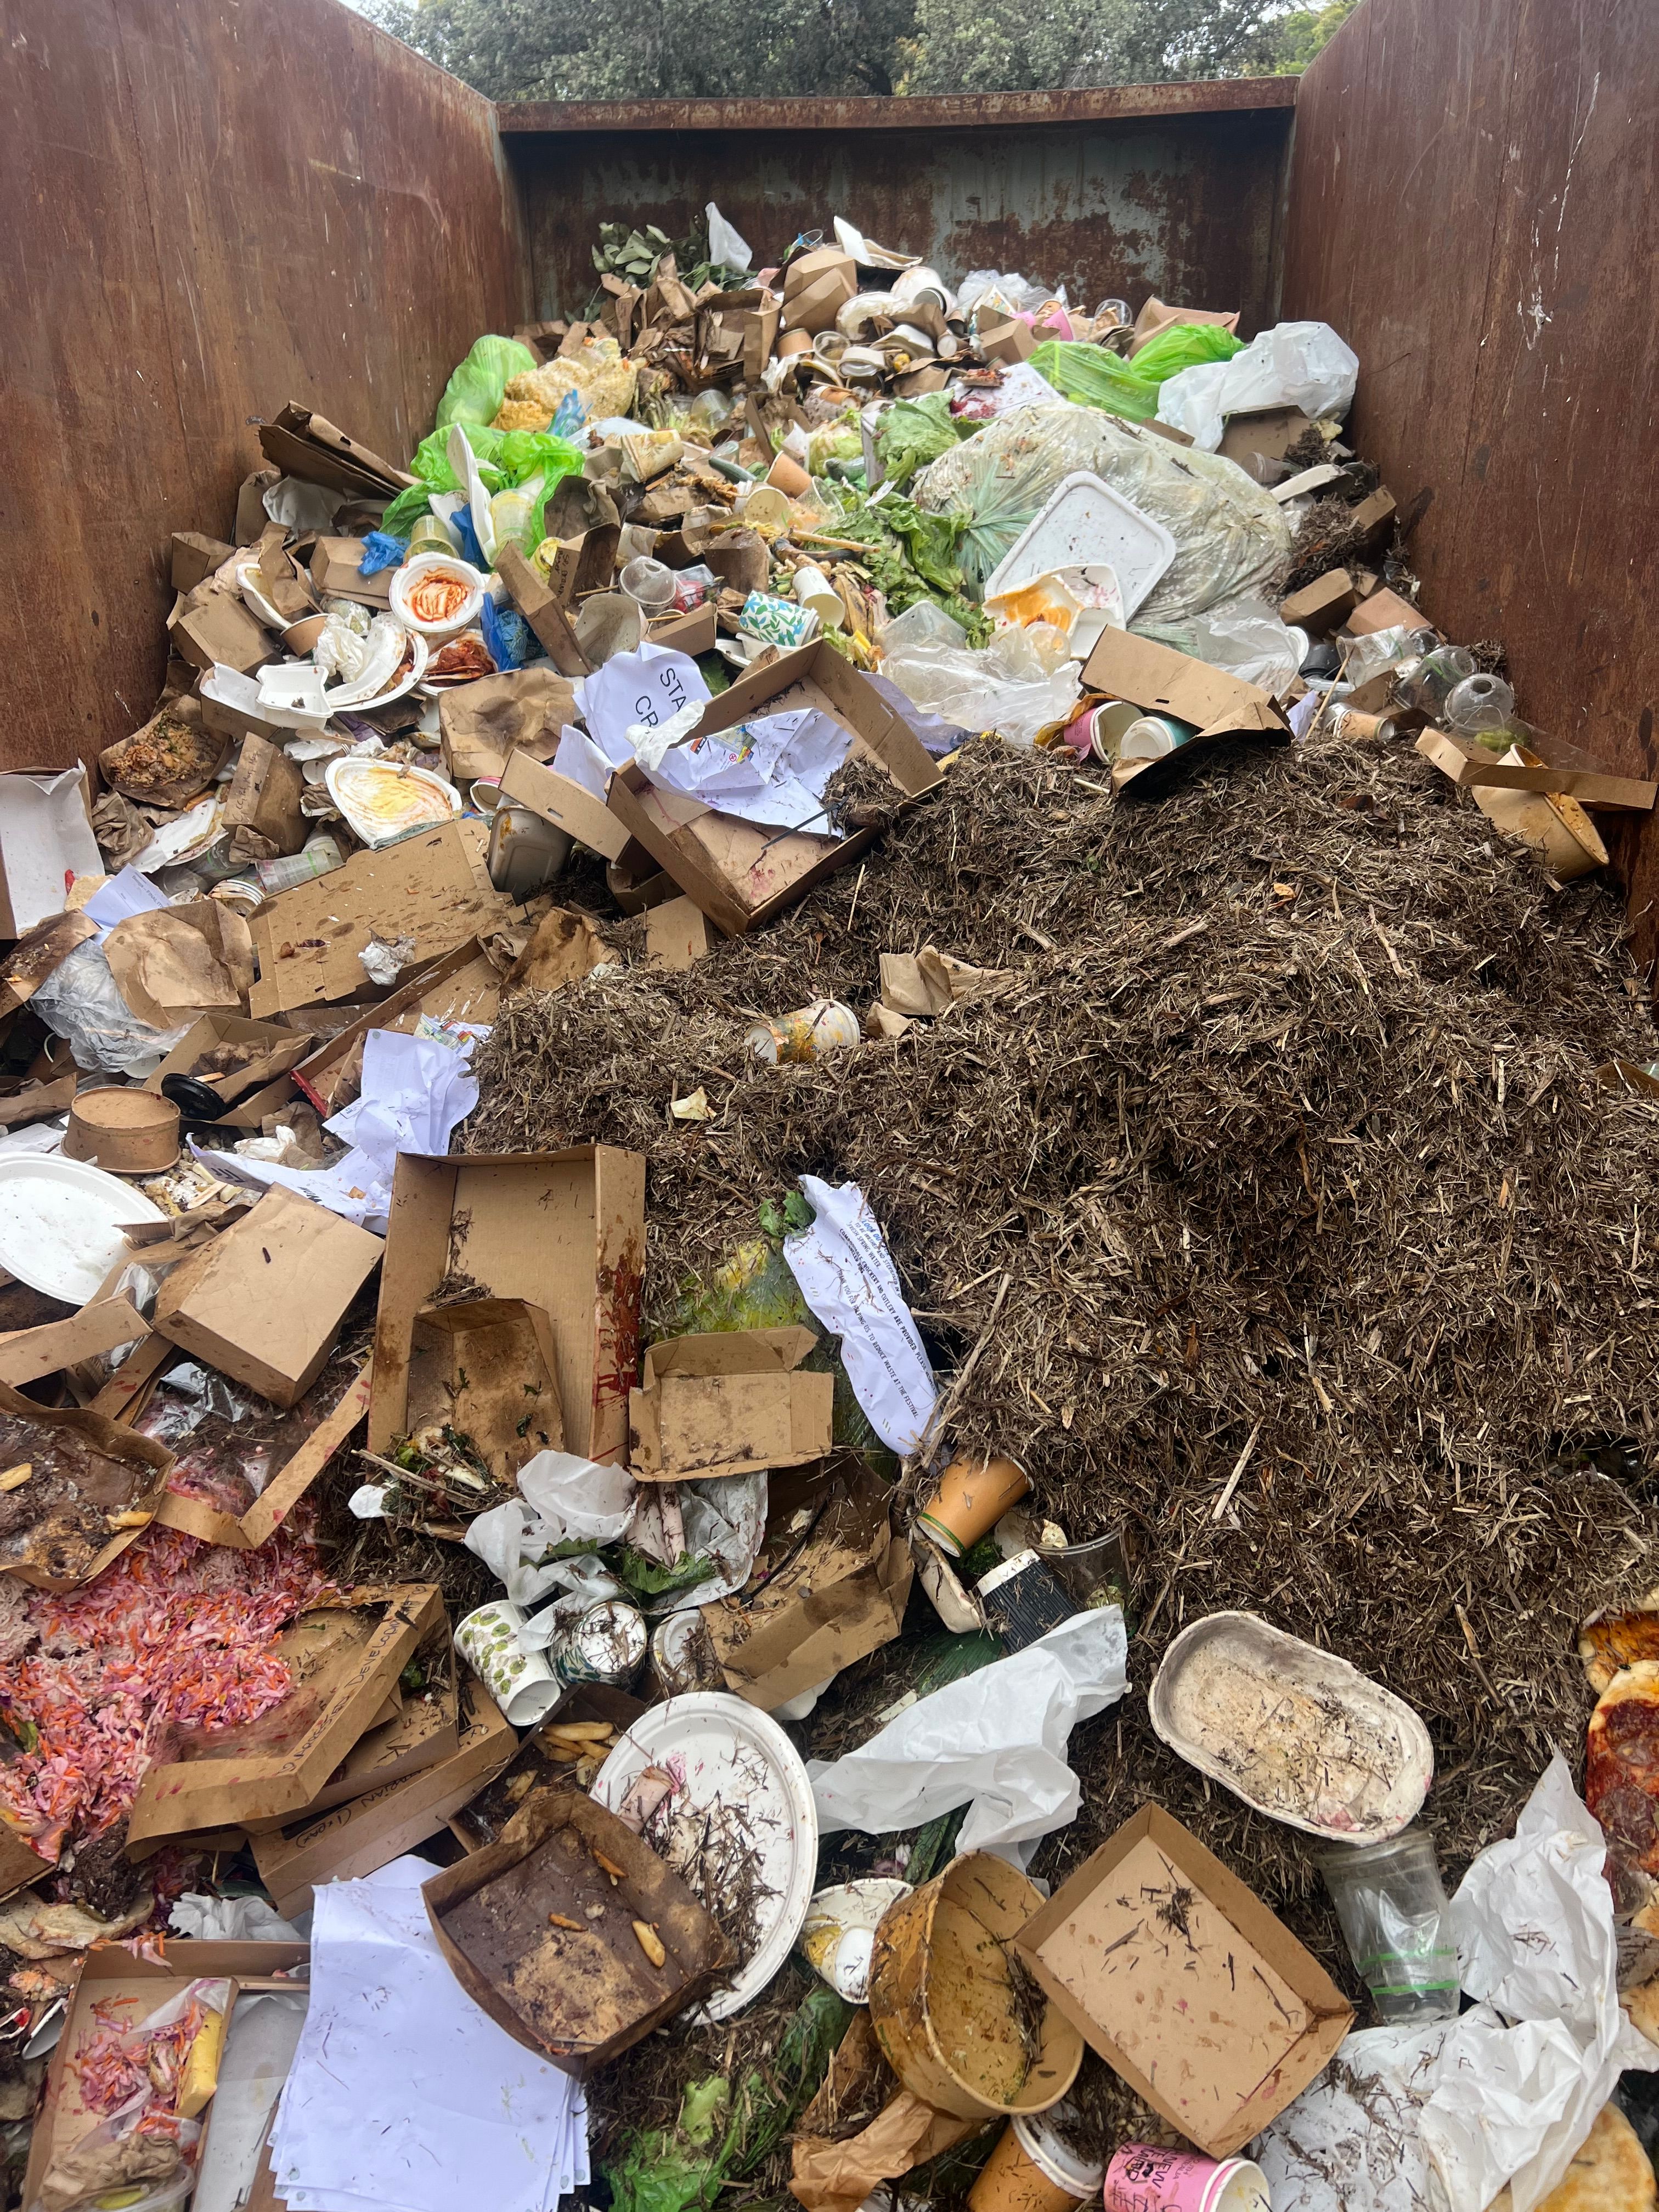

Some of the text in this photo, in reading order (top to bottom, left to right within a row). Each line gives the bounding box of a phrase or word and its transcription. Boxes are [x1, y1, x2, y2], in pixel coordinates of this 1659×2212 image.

[857, 1236, 871, 1252] SPRING
[881, 1293, 896, 1314] CUTLERY
[894, 1315, 902, 1326] ARE
[843, 1285, 851, 1295] YOU
[848, 1295, 856, 1304] FOR
[872, 1341, 887, 1360] REDUCE
[883, 1360, 896, 1378] WASTE
[898, 1386, 906, 1396] THE
[344, 1594, 411, 1688] DEVELOPMT
[1152, 2155, 1178, 2189] NEW
